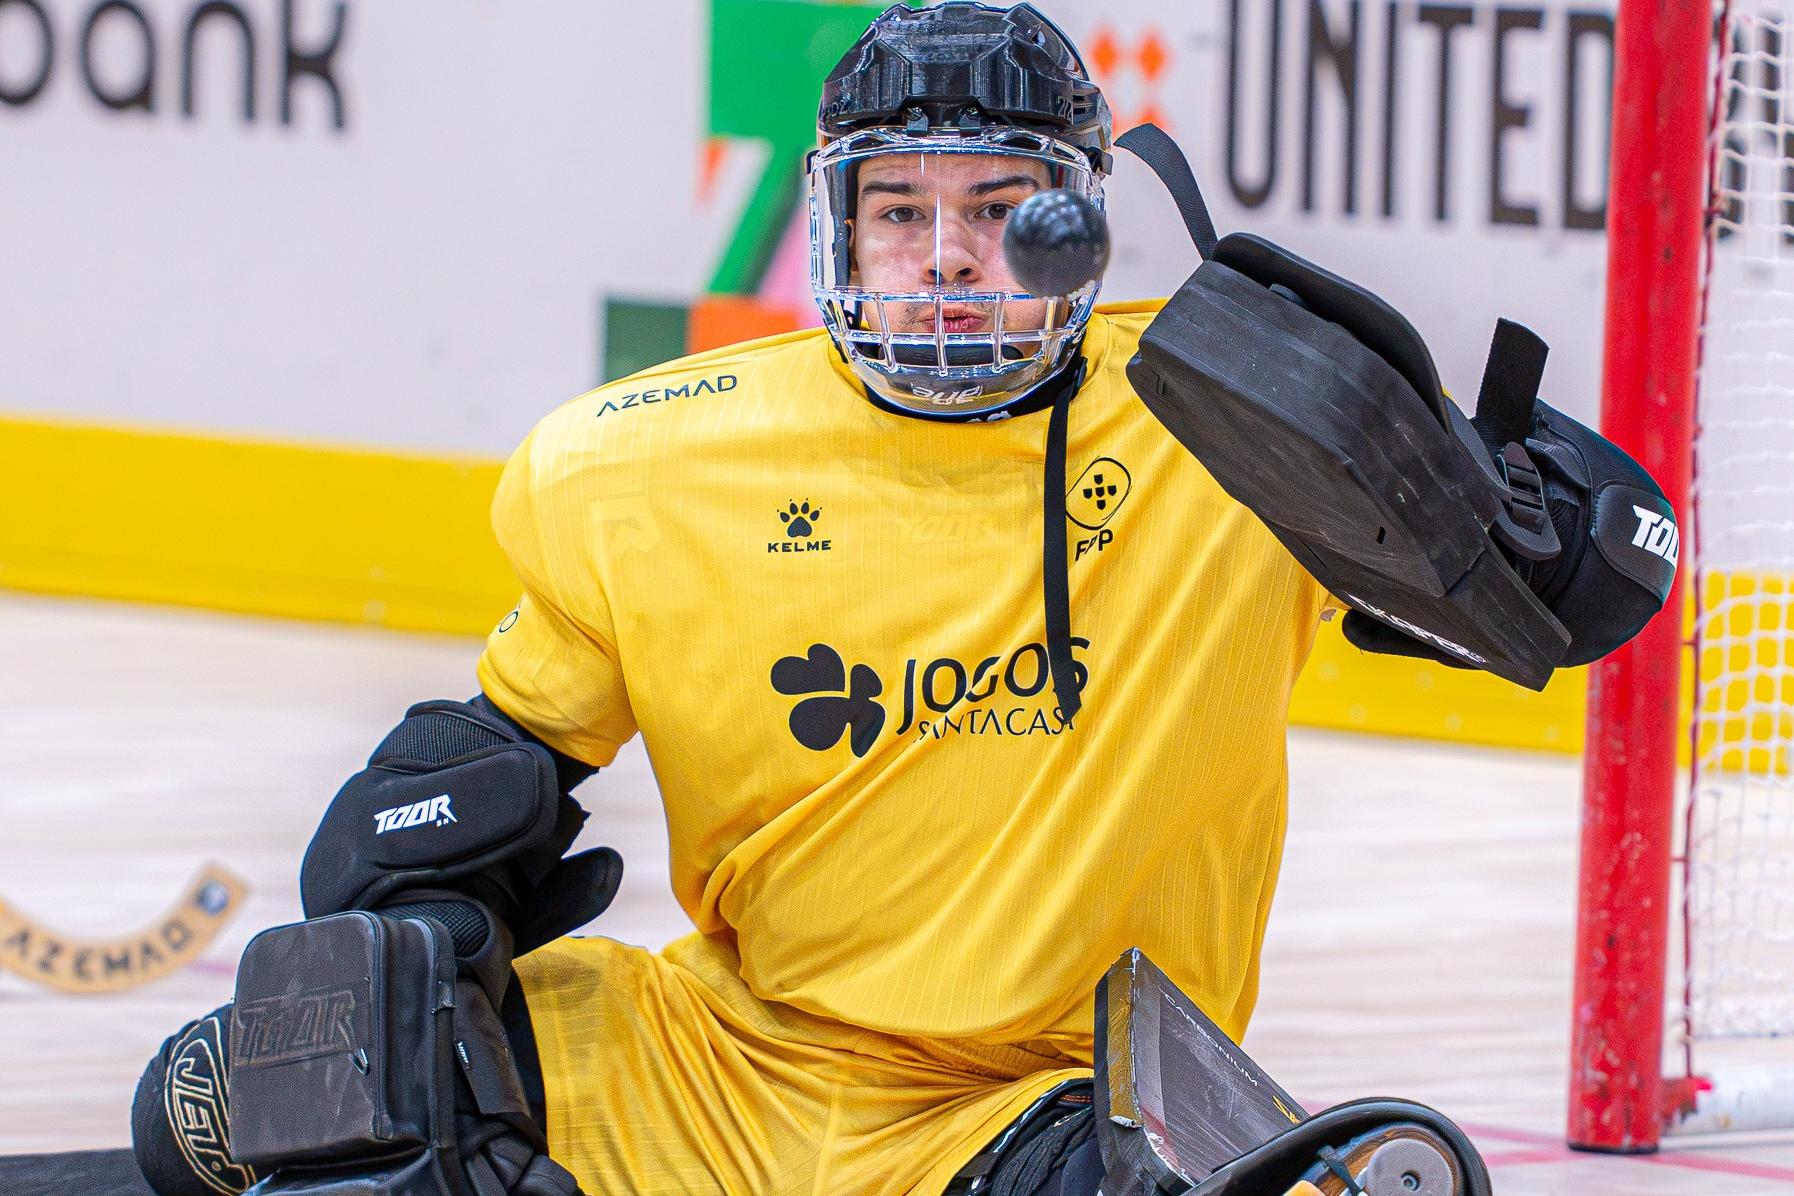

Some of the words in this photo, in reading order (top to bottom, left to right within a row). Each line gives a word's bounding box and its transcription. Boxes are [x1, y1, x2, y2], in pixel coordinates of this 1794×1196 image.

[1226, 0, 1614, 230] UNITED
[596, 374, 738, 417] AZEMAD
[767, 539, 832, 553] KELME
[1075, 529, 1113, 561] FPP
[373, 794, 458, 834] TOOR
[3, 918, 194, 982] AZEMAD
[1164, 993, 1258, 1087] CARBONIUM
